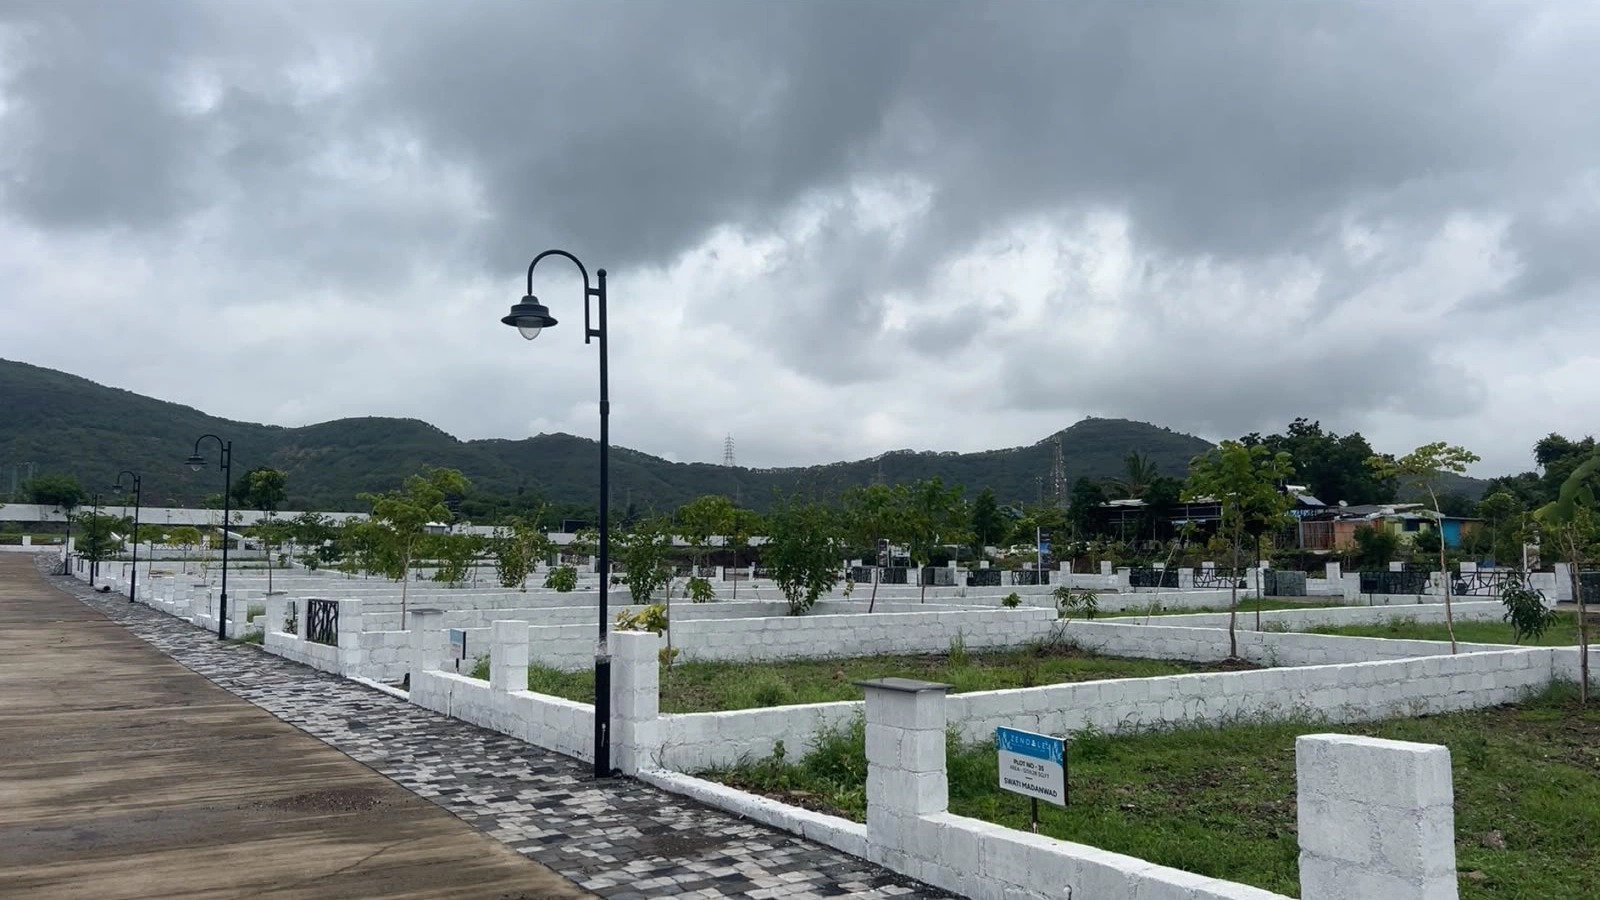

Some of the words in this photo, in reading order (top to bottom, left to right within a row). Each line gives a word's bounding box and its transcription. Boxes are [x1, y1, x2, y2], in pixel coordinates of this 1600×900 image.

[1013, 759, 1026, 767] PLOT
[1026, 761, 1035, 769] NO
[1004, 777, 1022, 788] SWATI
[1022, 782, 1058, 798] MADANWAD
